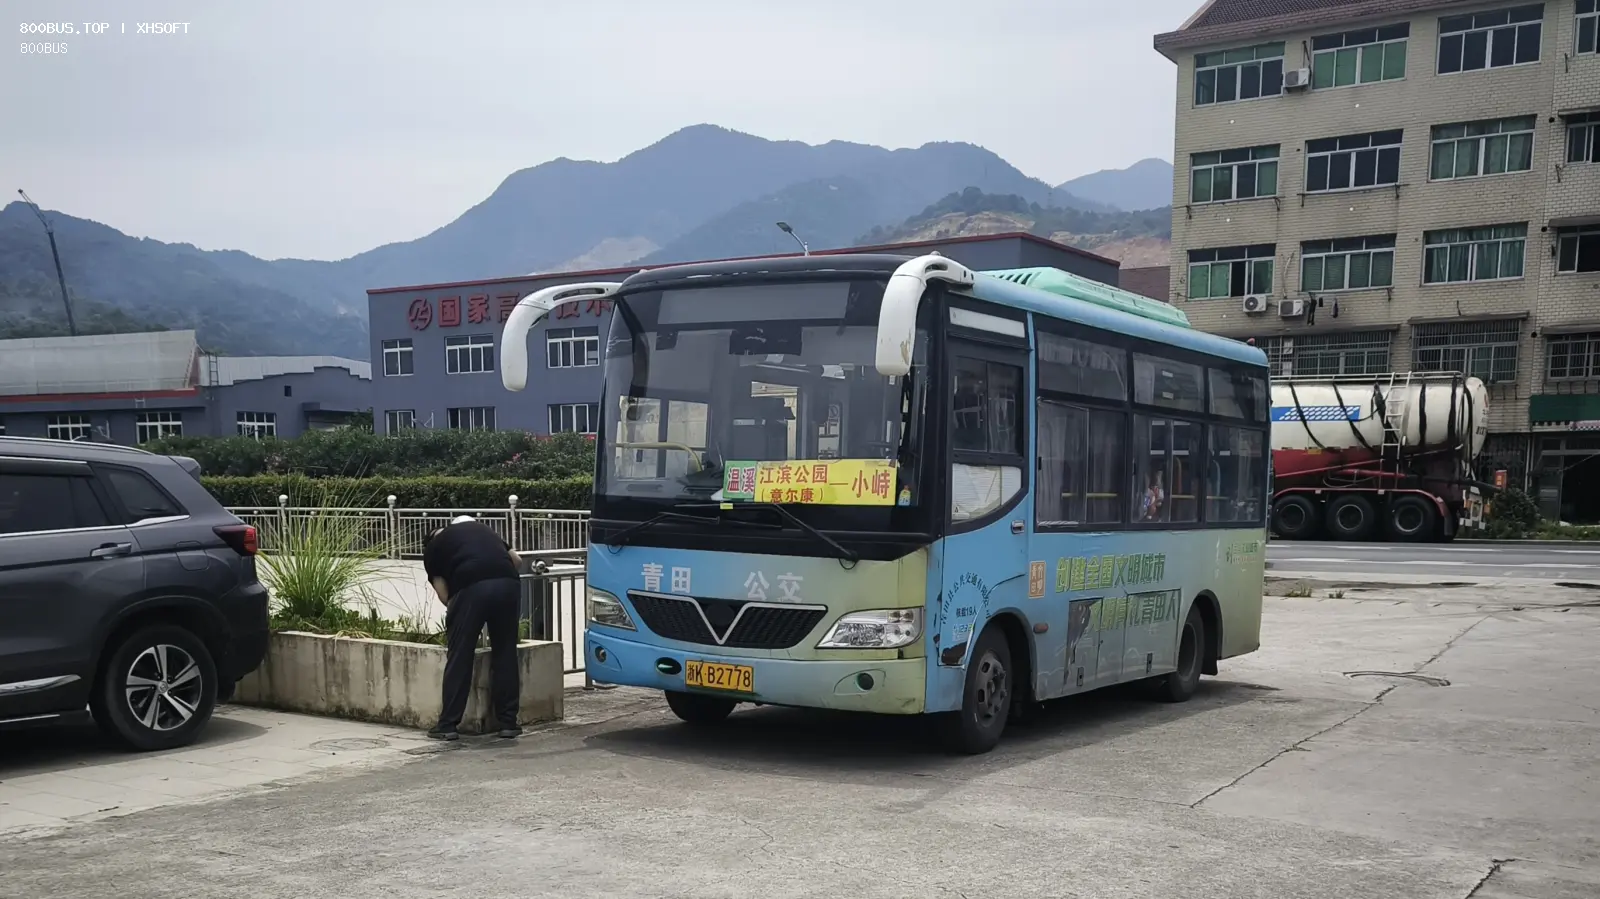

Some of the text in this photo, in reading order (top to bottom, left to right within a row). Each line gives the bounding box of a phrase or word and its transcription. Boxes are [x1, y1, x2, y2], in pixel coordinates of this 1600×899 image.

[727, 466, 757, 493] 温溪
[759, 464, 828, 484] 江滨公园
[640, 562, 804, 602] 青田 公交
